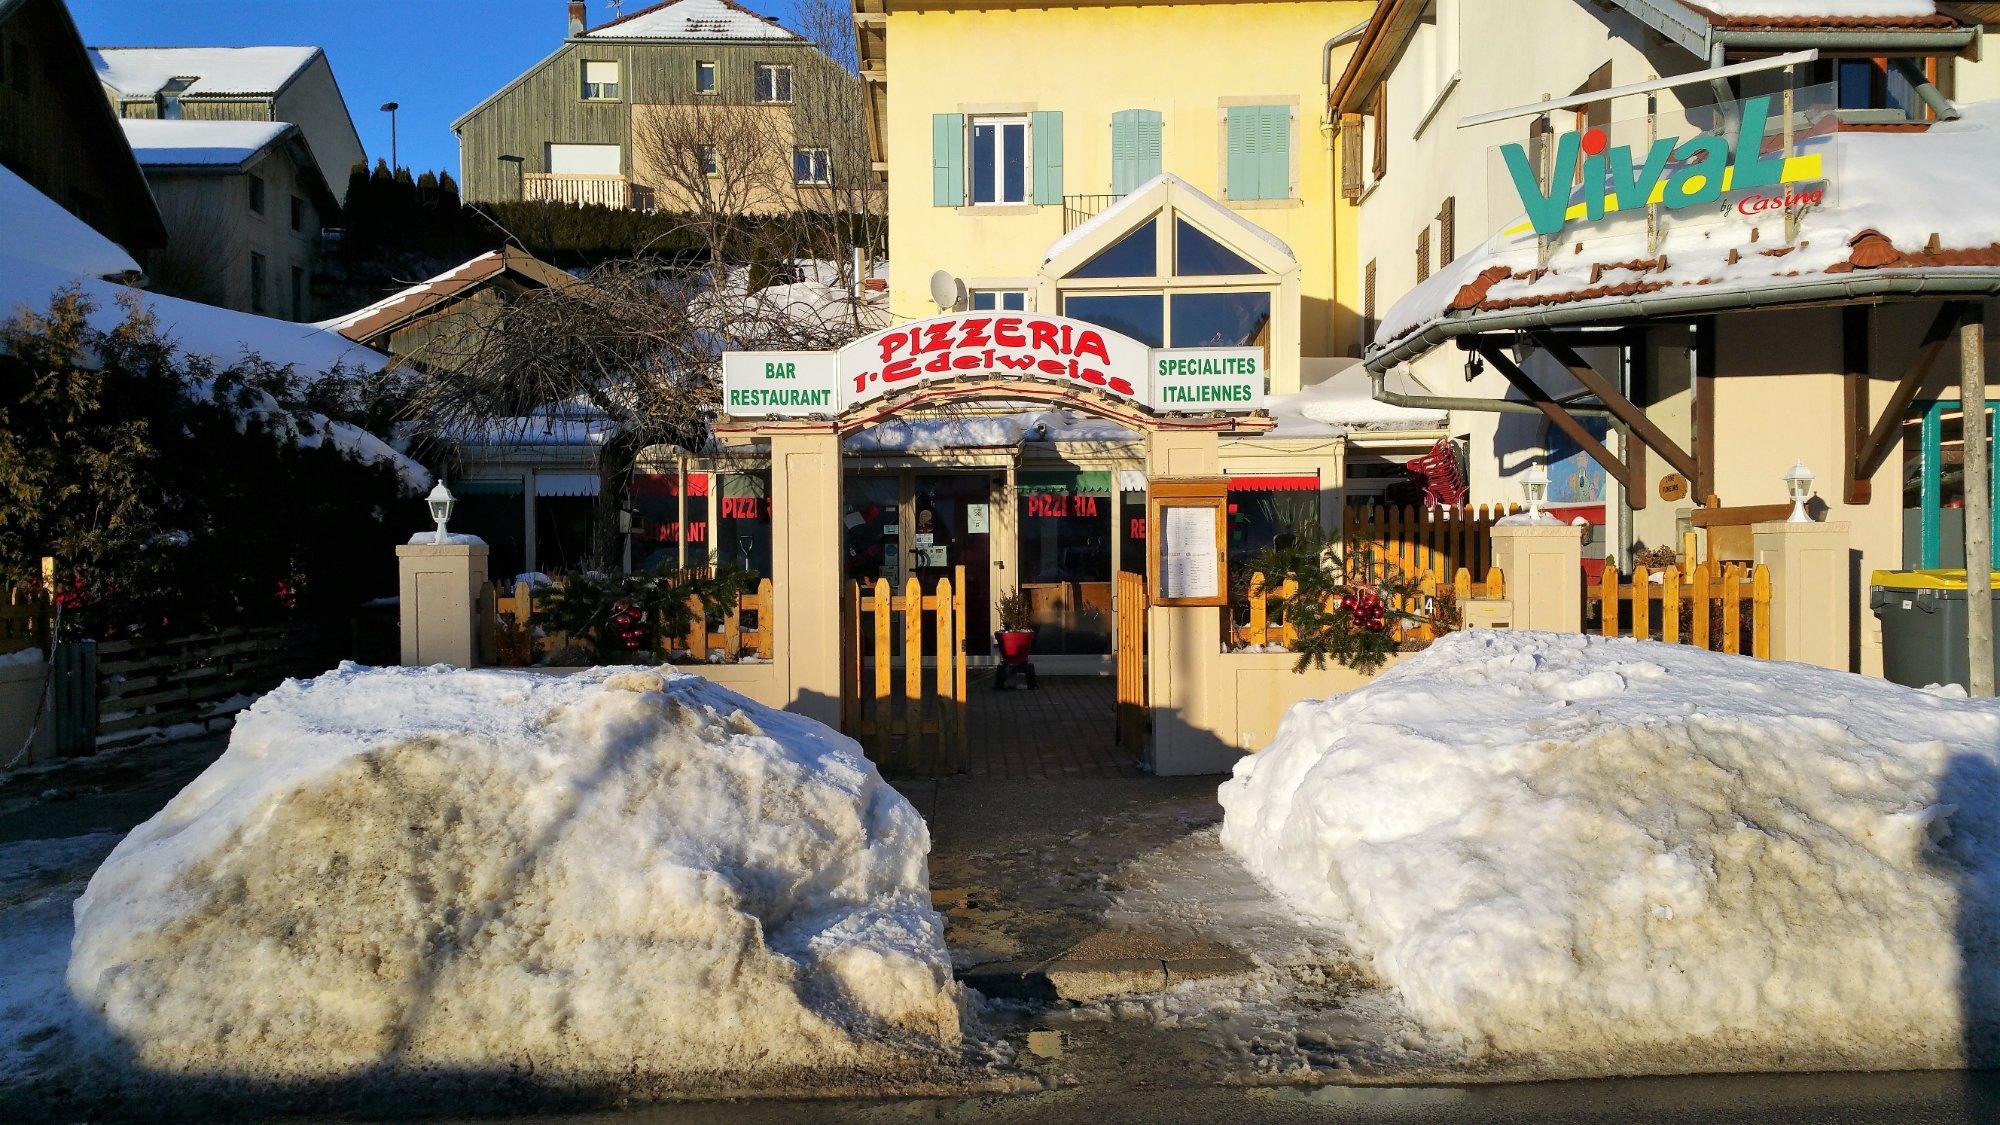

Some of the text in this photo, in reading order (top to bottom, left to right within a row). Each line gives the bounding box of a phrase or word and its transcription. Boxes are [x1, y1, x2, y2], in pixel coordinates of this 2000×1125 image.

[1720, 188, 1823, 217] by Casino
[878, 318, 1110, 365] PIZZERIA
[765, 362, 796, 379] BAR
[1158, 357, 1256, 376] SPECIALITES
[730, 389, 831, 406] RESTAURANT
[1163, 384, 1252, 402] ITALIENNES
[1130, 518, 1146, 539] RE
